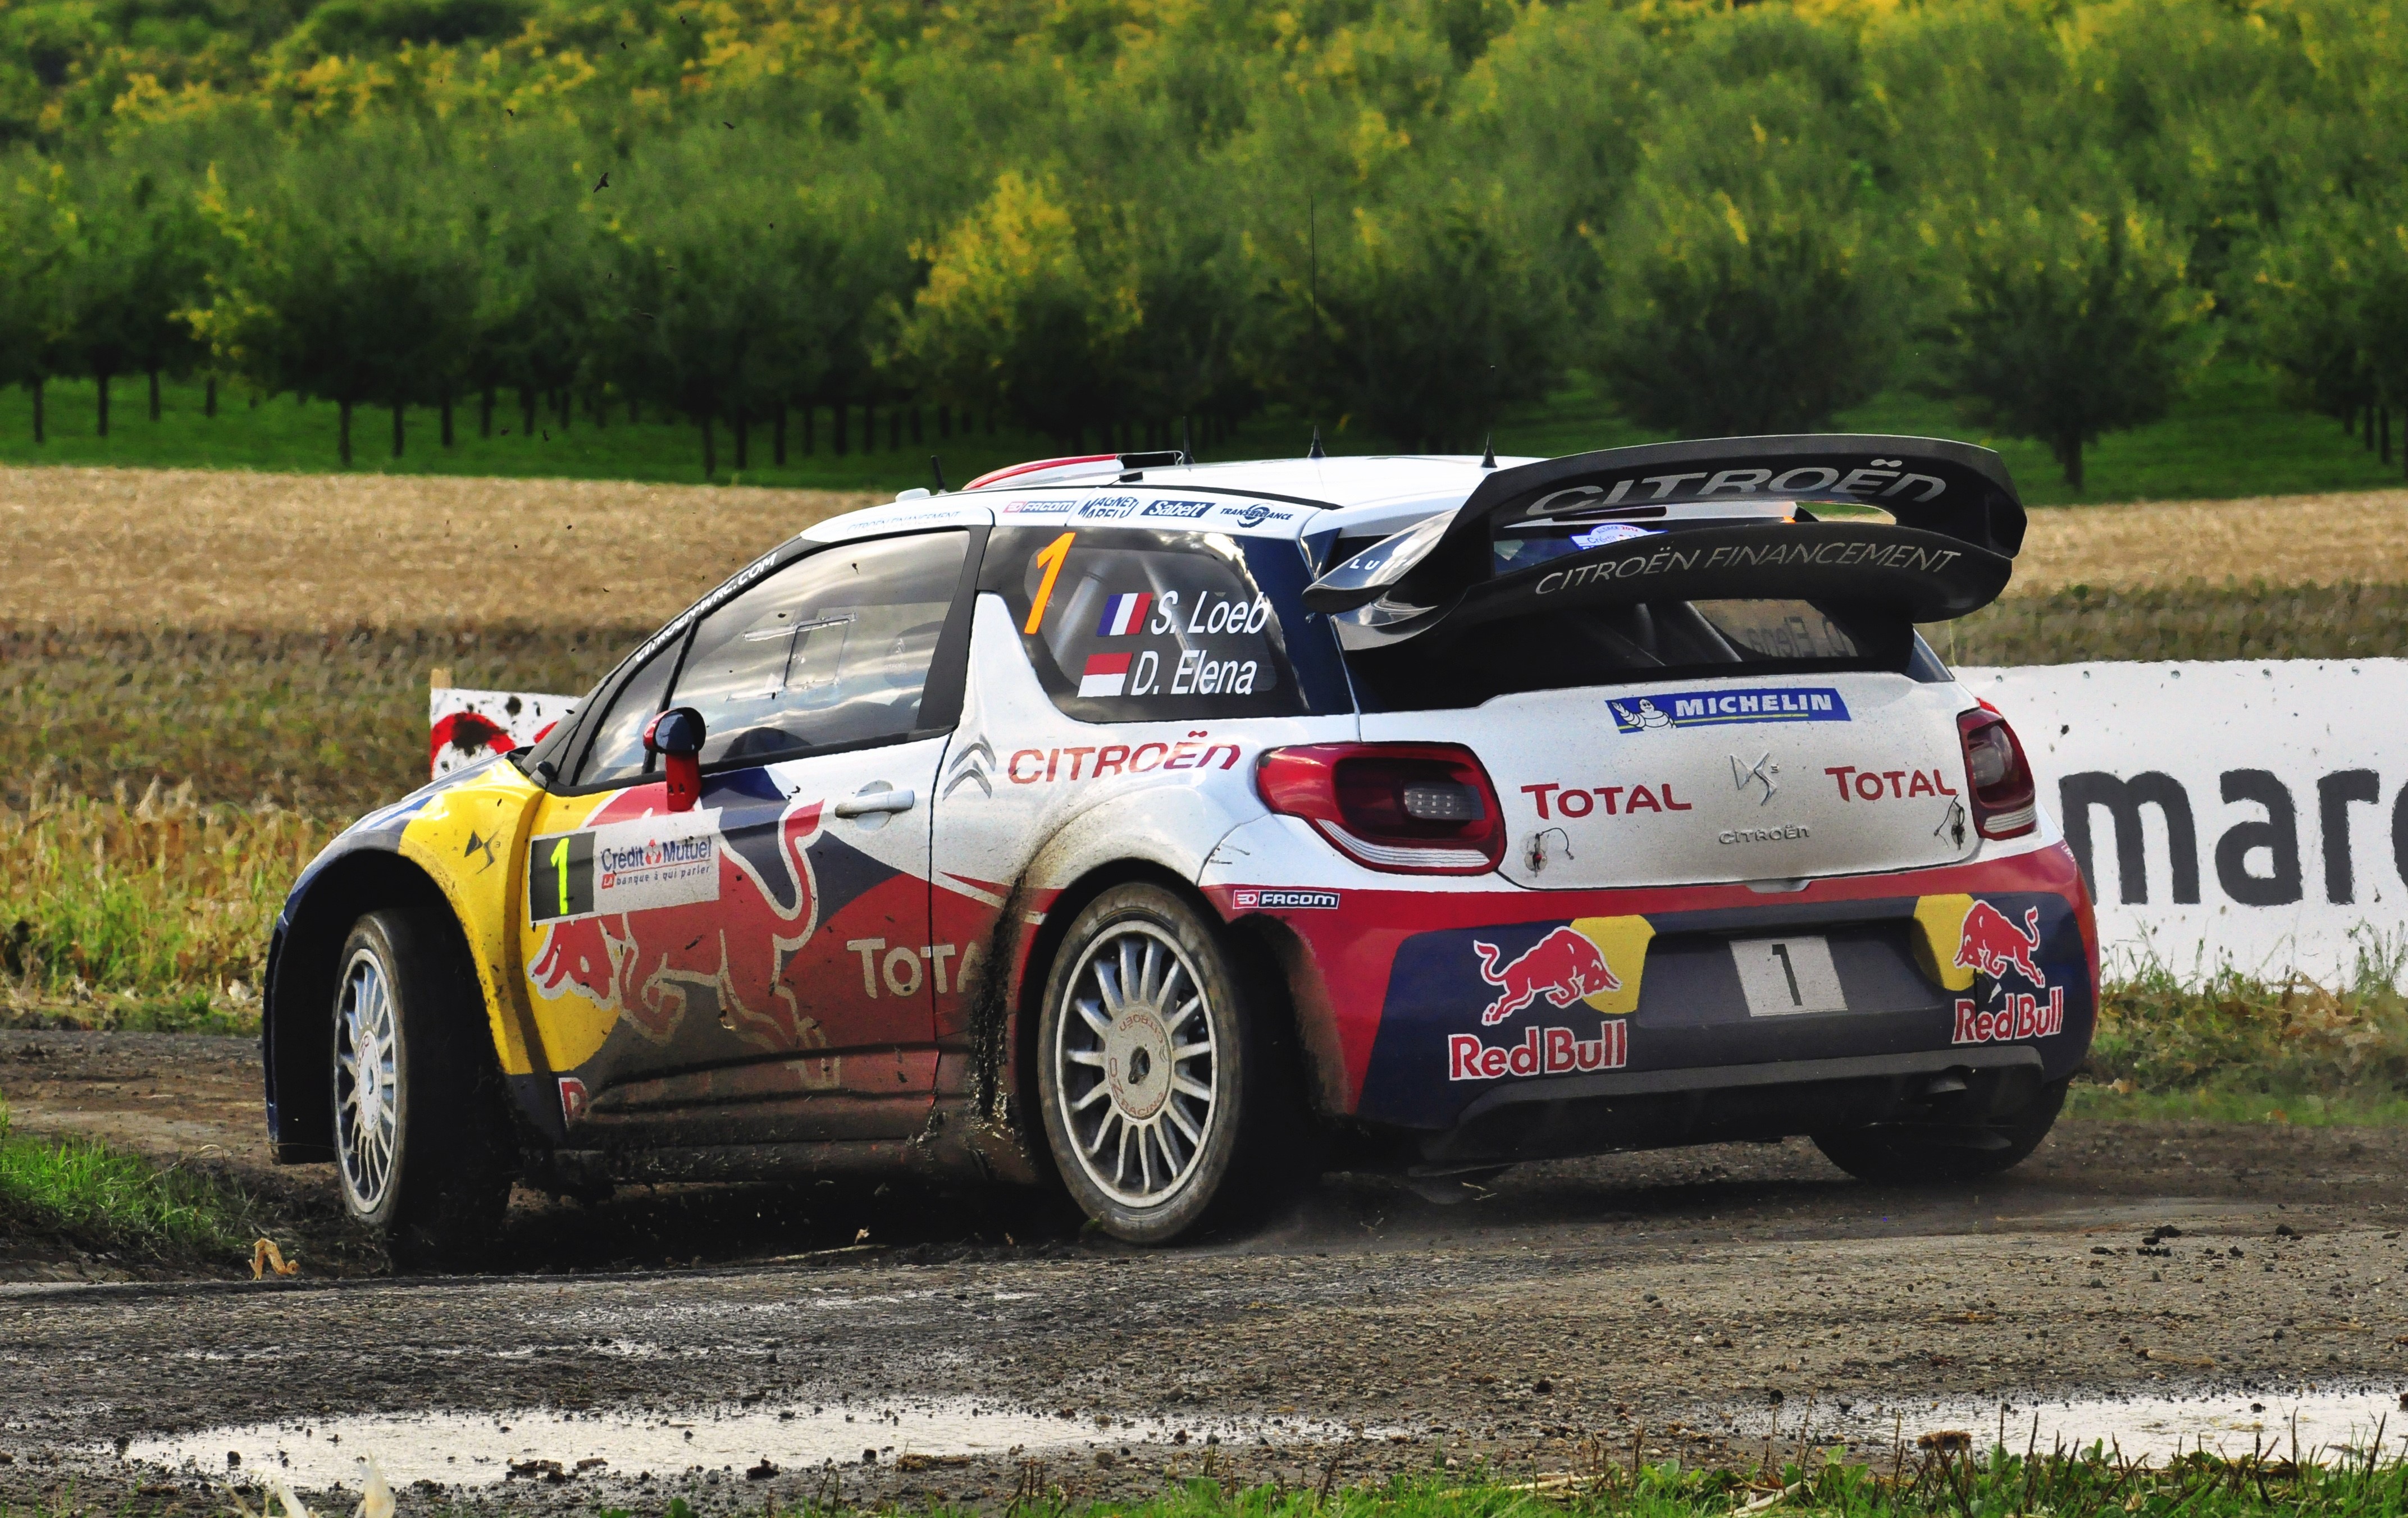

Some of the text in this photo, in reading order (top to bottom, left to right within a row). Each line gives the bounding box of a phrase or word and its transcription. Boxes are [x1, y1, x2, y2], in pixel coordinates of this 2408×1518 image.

[1023, 502, 1073, 512] FACOM
[1149, 501, 1203, 516] Sabelt
[1024, 532, 1076, 634] 1
[1535, 543, 1962, 595] CITROËN FINANCEMENT
[1151, 591, 1270, 635] S. Loeb
[1130, 650, 1257, 696] D. Elena
[1676, 694, 1833, 717] MICHELIN
[1521, 783, 1693, 820] TOTAL
[1825, 766, 1957, 802] TOTAL
[601, 835, 712, 872] Crédit Mutuel
[550, 836, 569, 915] 1
[617, 874, 649, 886] banque
[663, 871, 677, 881] qui
[681, 865, 710, 880] parler
[1261, 893, 1335, 906] FACOM
[1772, 943, 1803, 1007] 1
[1951, 986, 2064, 1044] Red Bull
[1448, 1019, 1627, 1081] Red Bull
